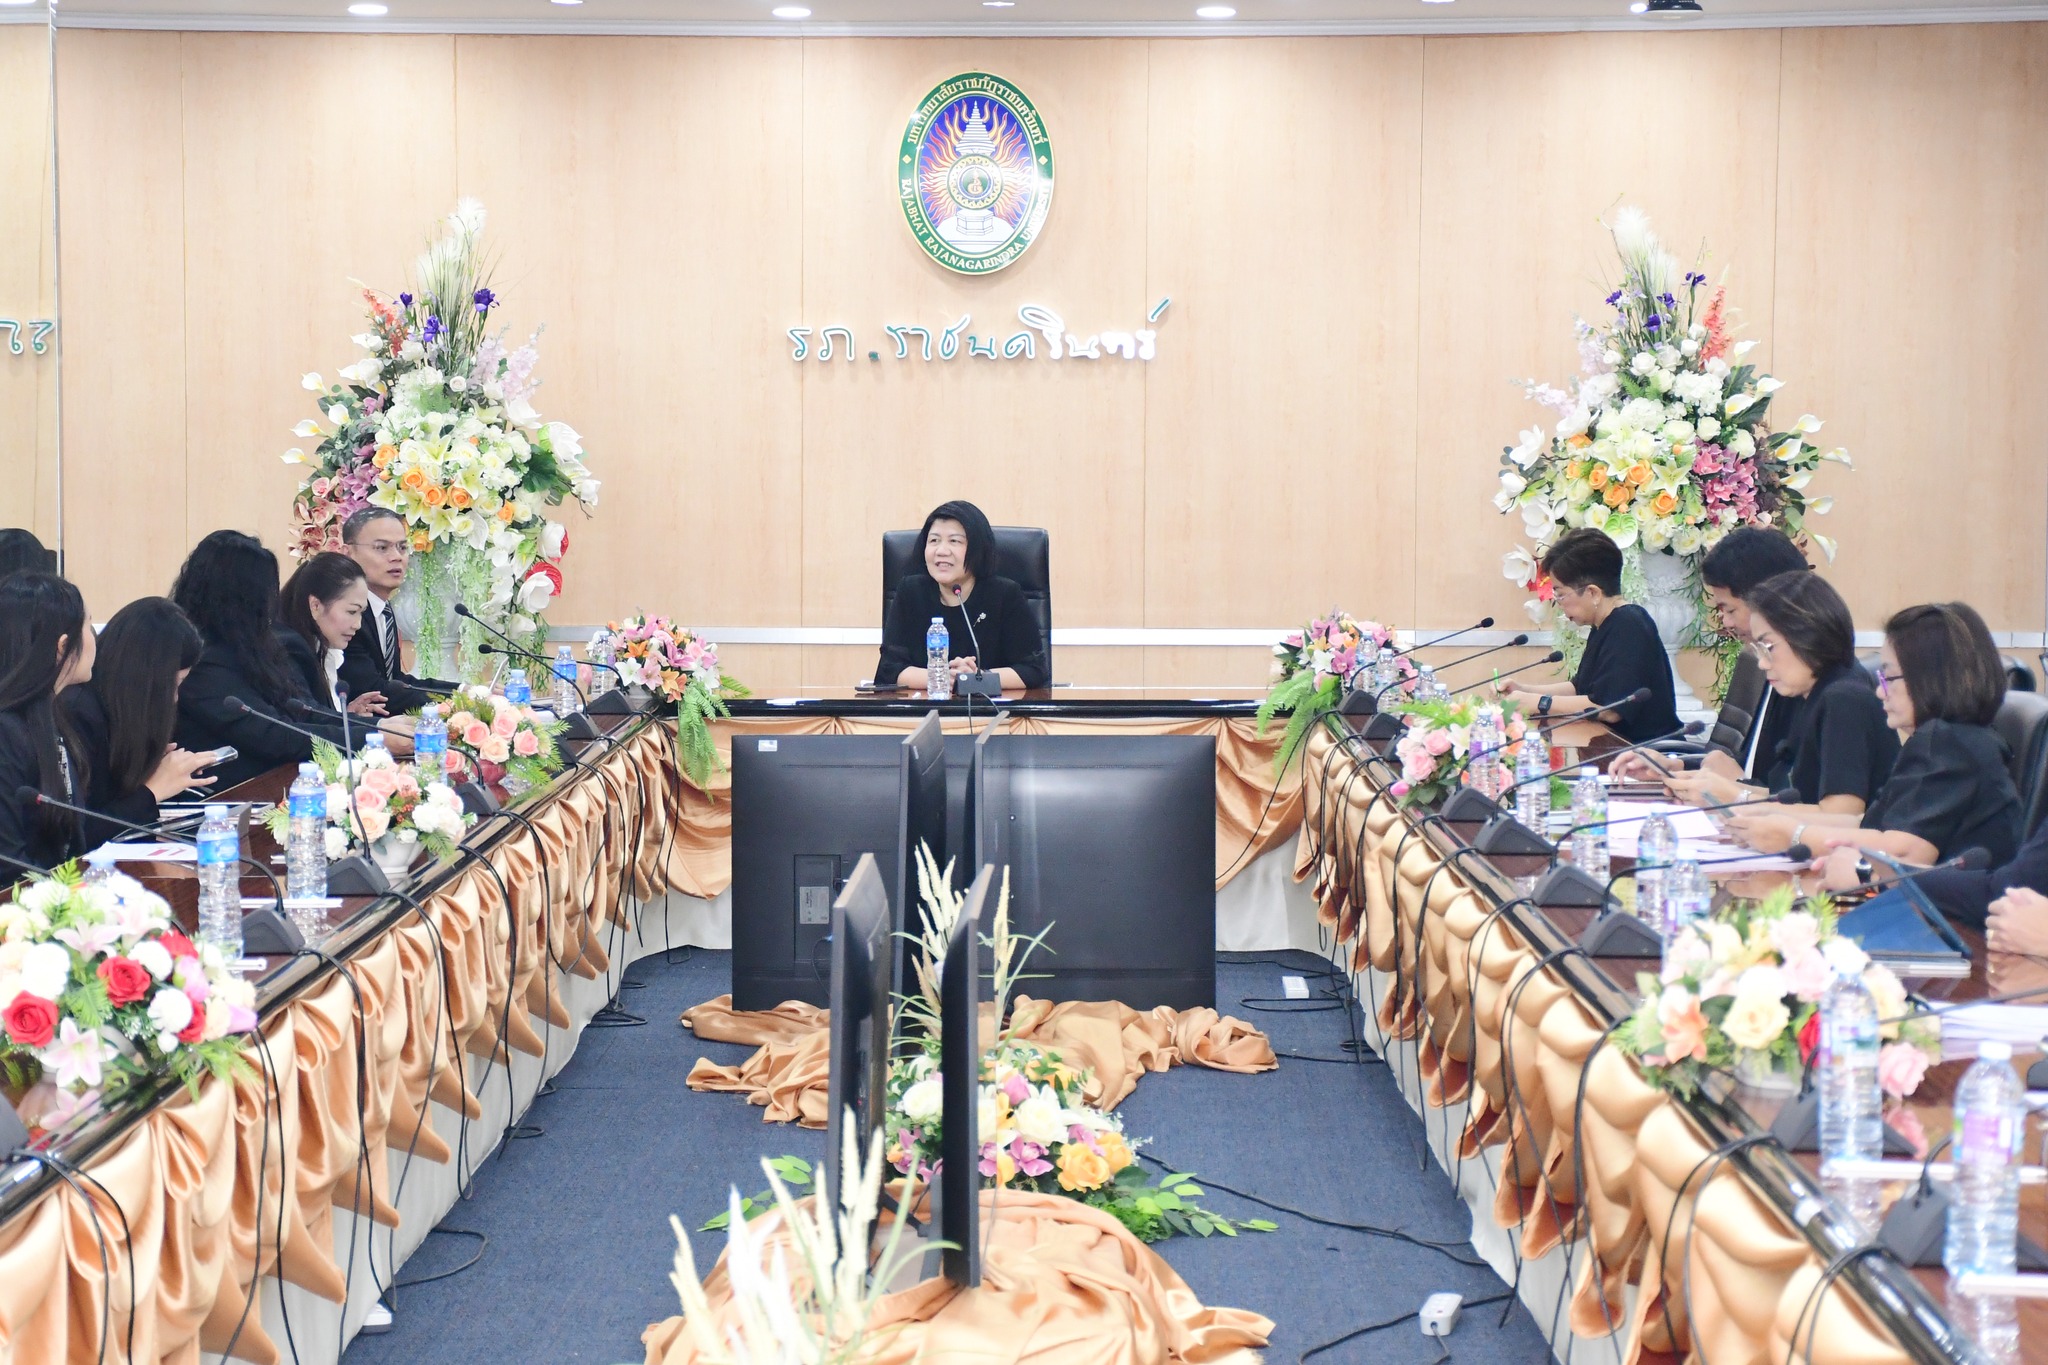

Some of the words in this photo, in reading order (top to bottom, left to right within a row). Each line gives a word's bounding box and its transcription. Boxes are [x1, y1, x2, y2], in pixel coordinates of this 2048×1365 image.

[907, 76, 1049, 145] มหาวทยาลัยราชภัฏราชนครินทร์
[901, 178, 928, 239] RAJABHAT
[924, 238, 1025, 270] RAJANAGARINDRA
